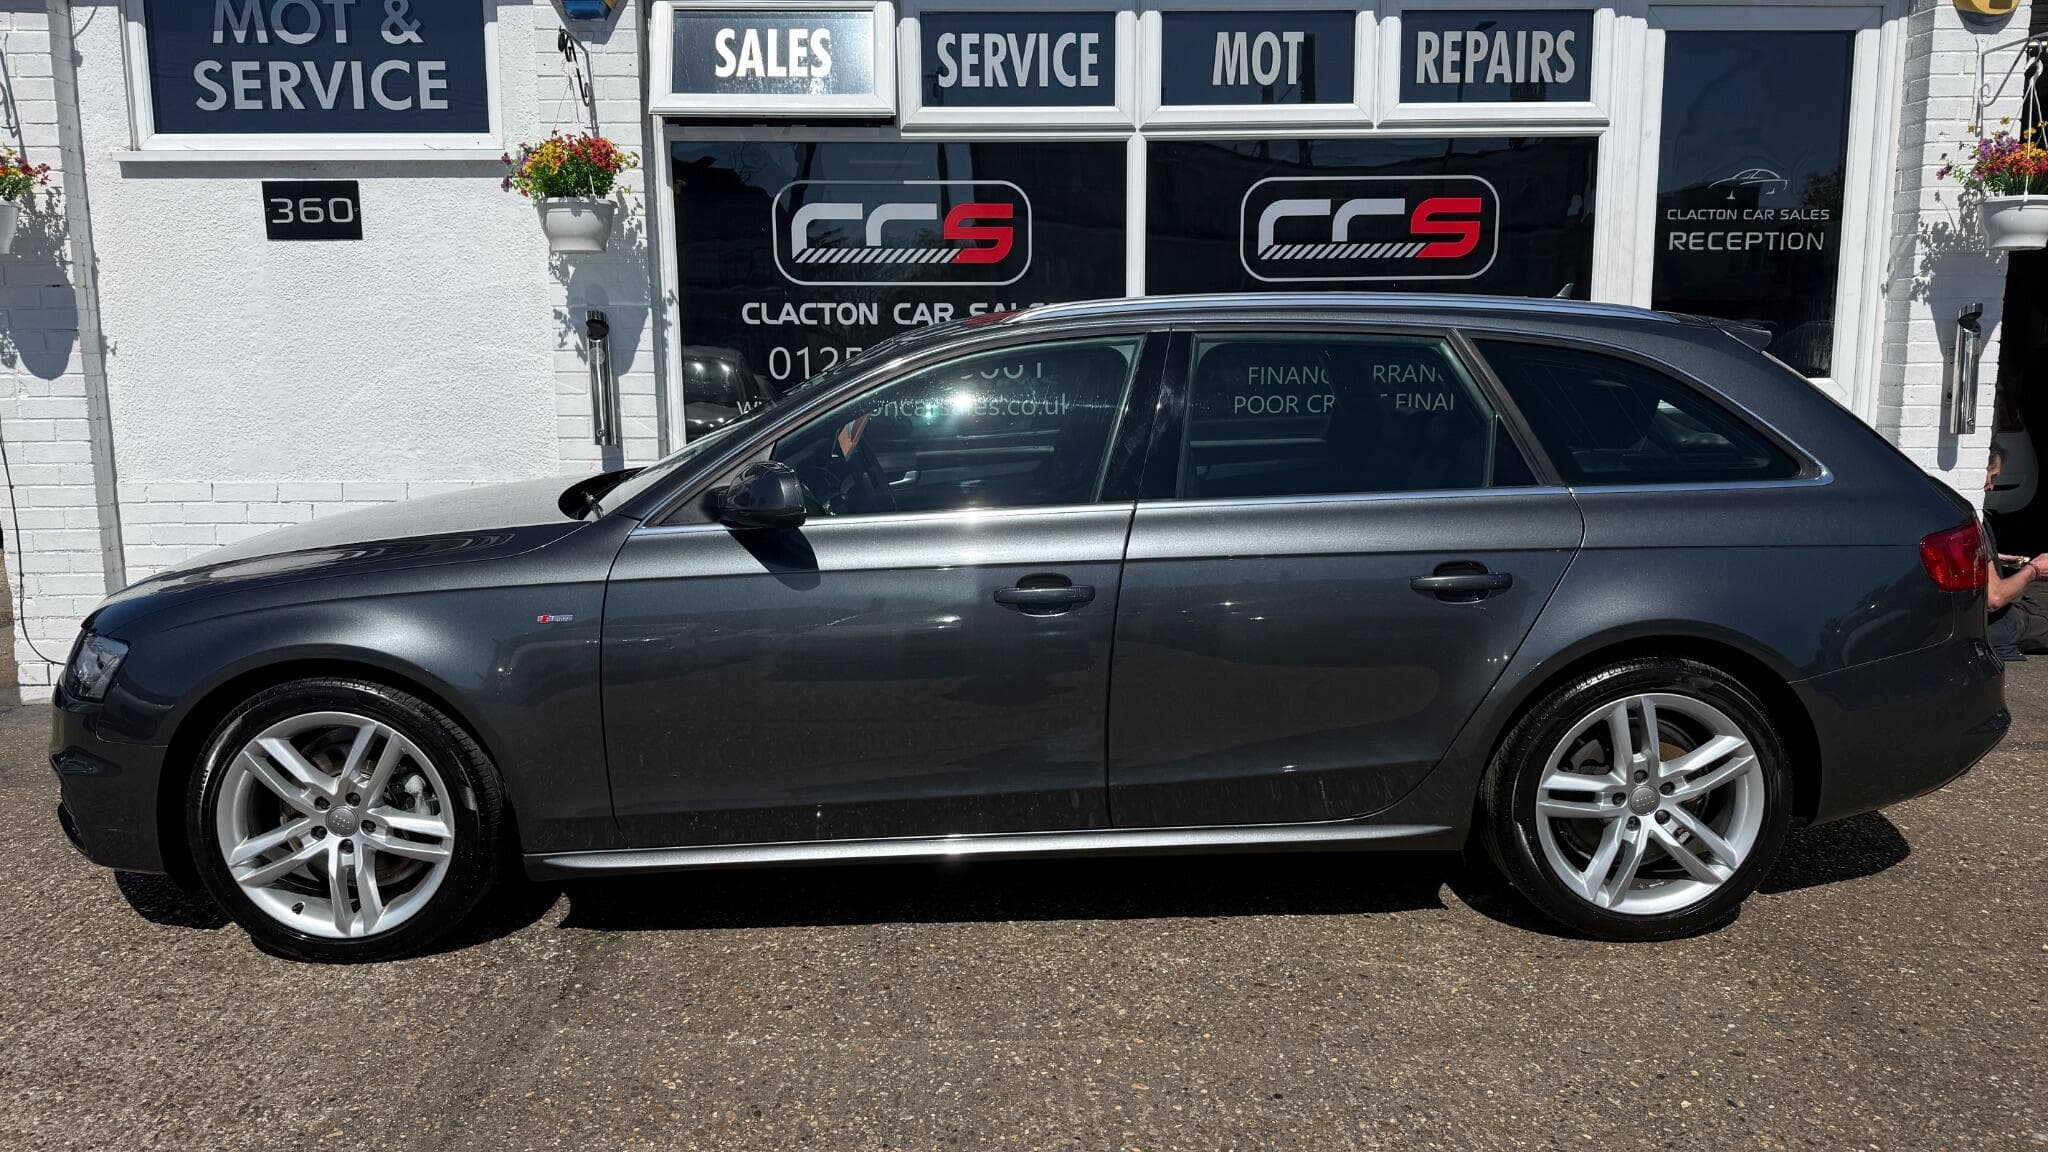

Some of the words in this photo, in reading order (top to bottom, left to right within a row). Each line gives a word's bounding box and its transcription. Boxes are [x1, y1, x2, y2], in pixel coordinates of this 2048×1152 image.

[212, 0, 354, 45] MOT
[380, 0, 424, 45] &
[714, 27, 832, 78] SALES
[937, 32, 1099, 88] SERVICE
[1212, 31, 1305, 86] MOT
[1416, 29, 1576, 84] REPAIRS
[193, 59, 449, 111] SERVICE
[270, 197, 354, 224] 360
[1667, 208, 1738, 220] CLACTON
[1743, 208, 1775, 220] CAR
[1780, 208, 1830, 220] SALES
[1668, 231, 1825, 251] RECEPTION
[741, 302, 878, 326] CLACTON
[893, 302, 954, 324] CAR
[1234, 395, 1299, 415] POOR
